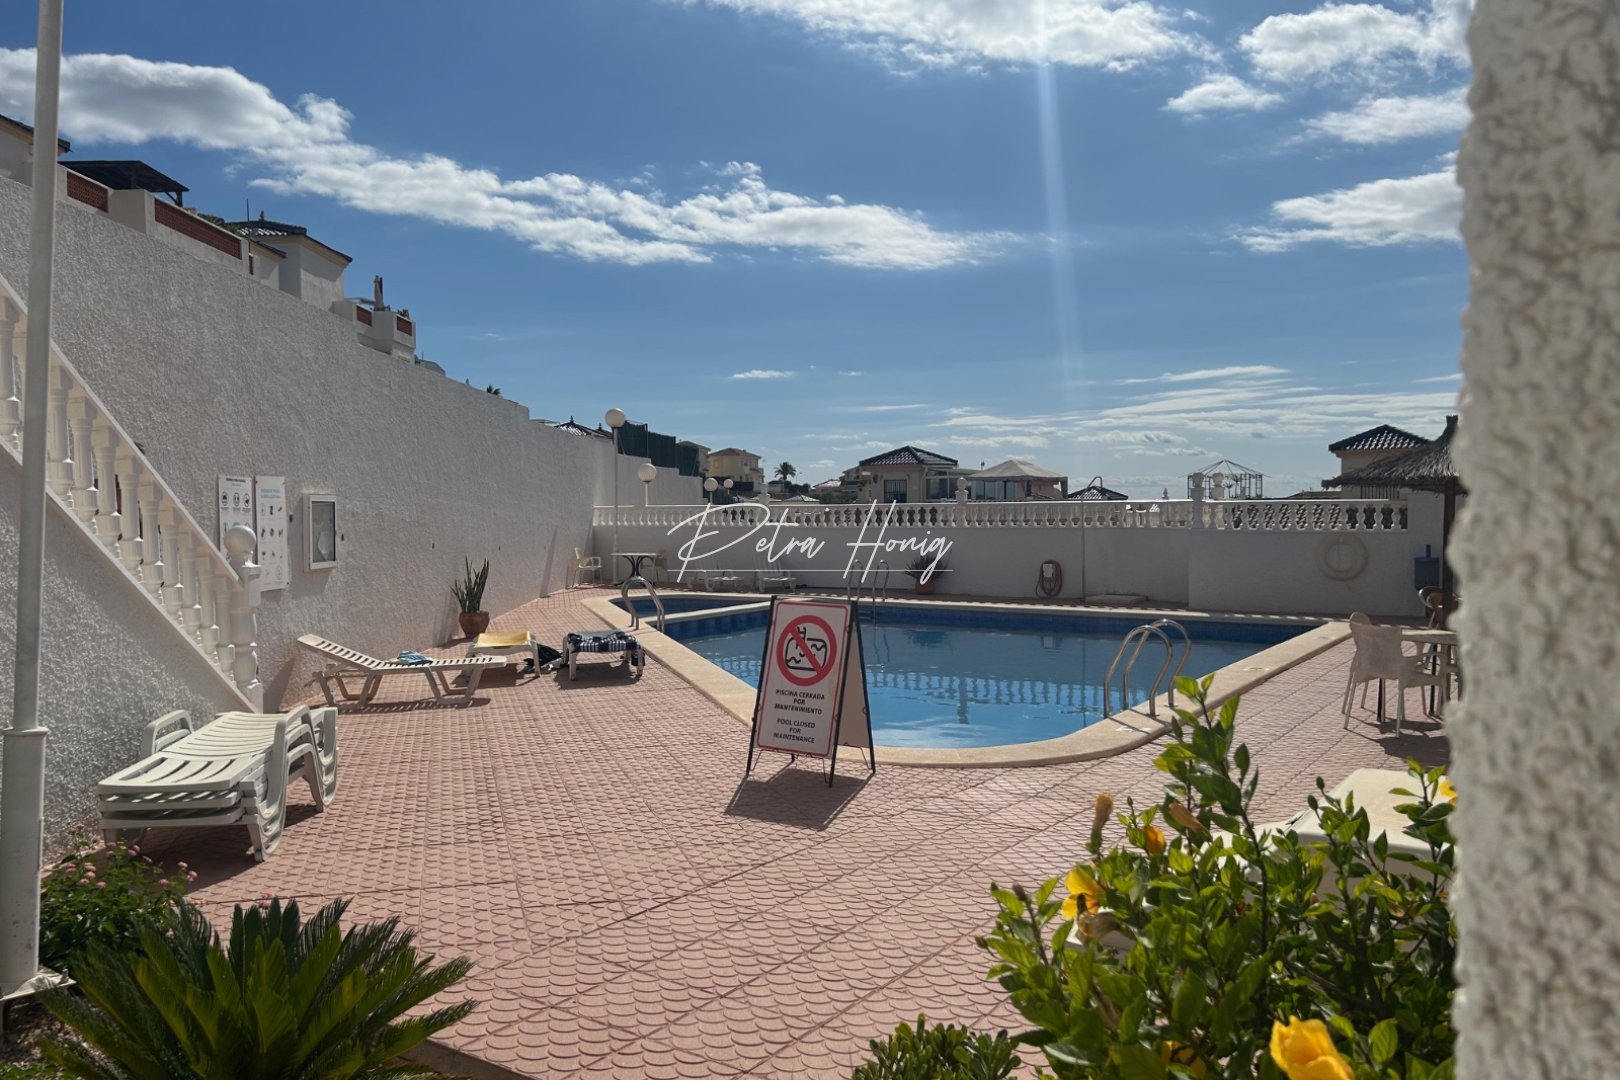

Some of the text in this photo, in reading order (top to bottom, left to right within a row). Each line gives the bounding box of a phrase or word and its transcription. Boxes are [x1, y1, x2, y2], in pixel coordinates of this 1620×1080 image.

[774, 704, 822, 714] MANTENIMIENTO
[794, 720, 816, 728] CLOSED
[774, 732, 815, 743] MAINTENANCE
